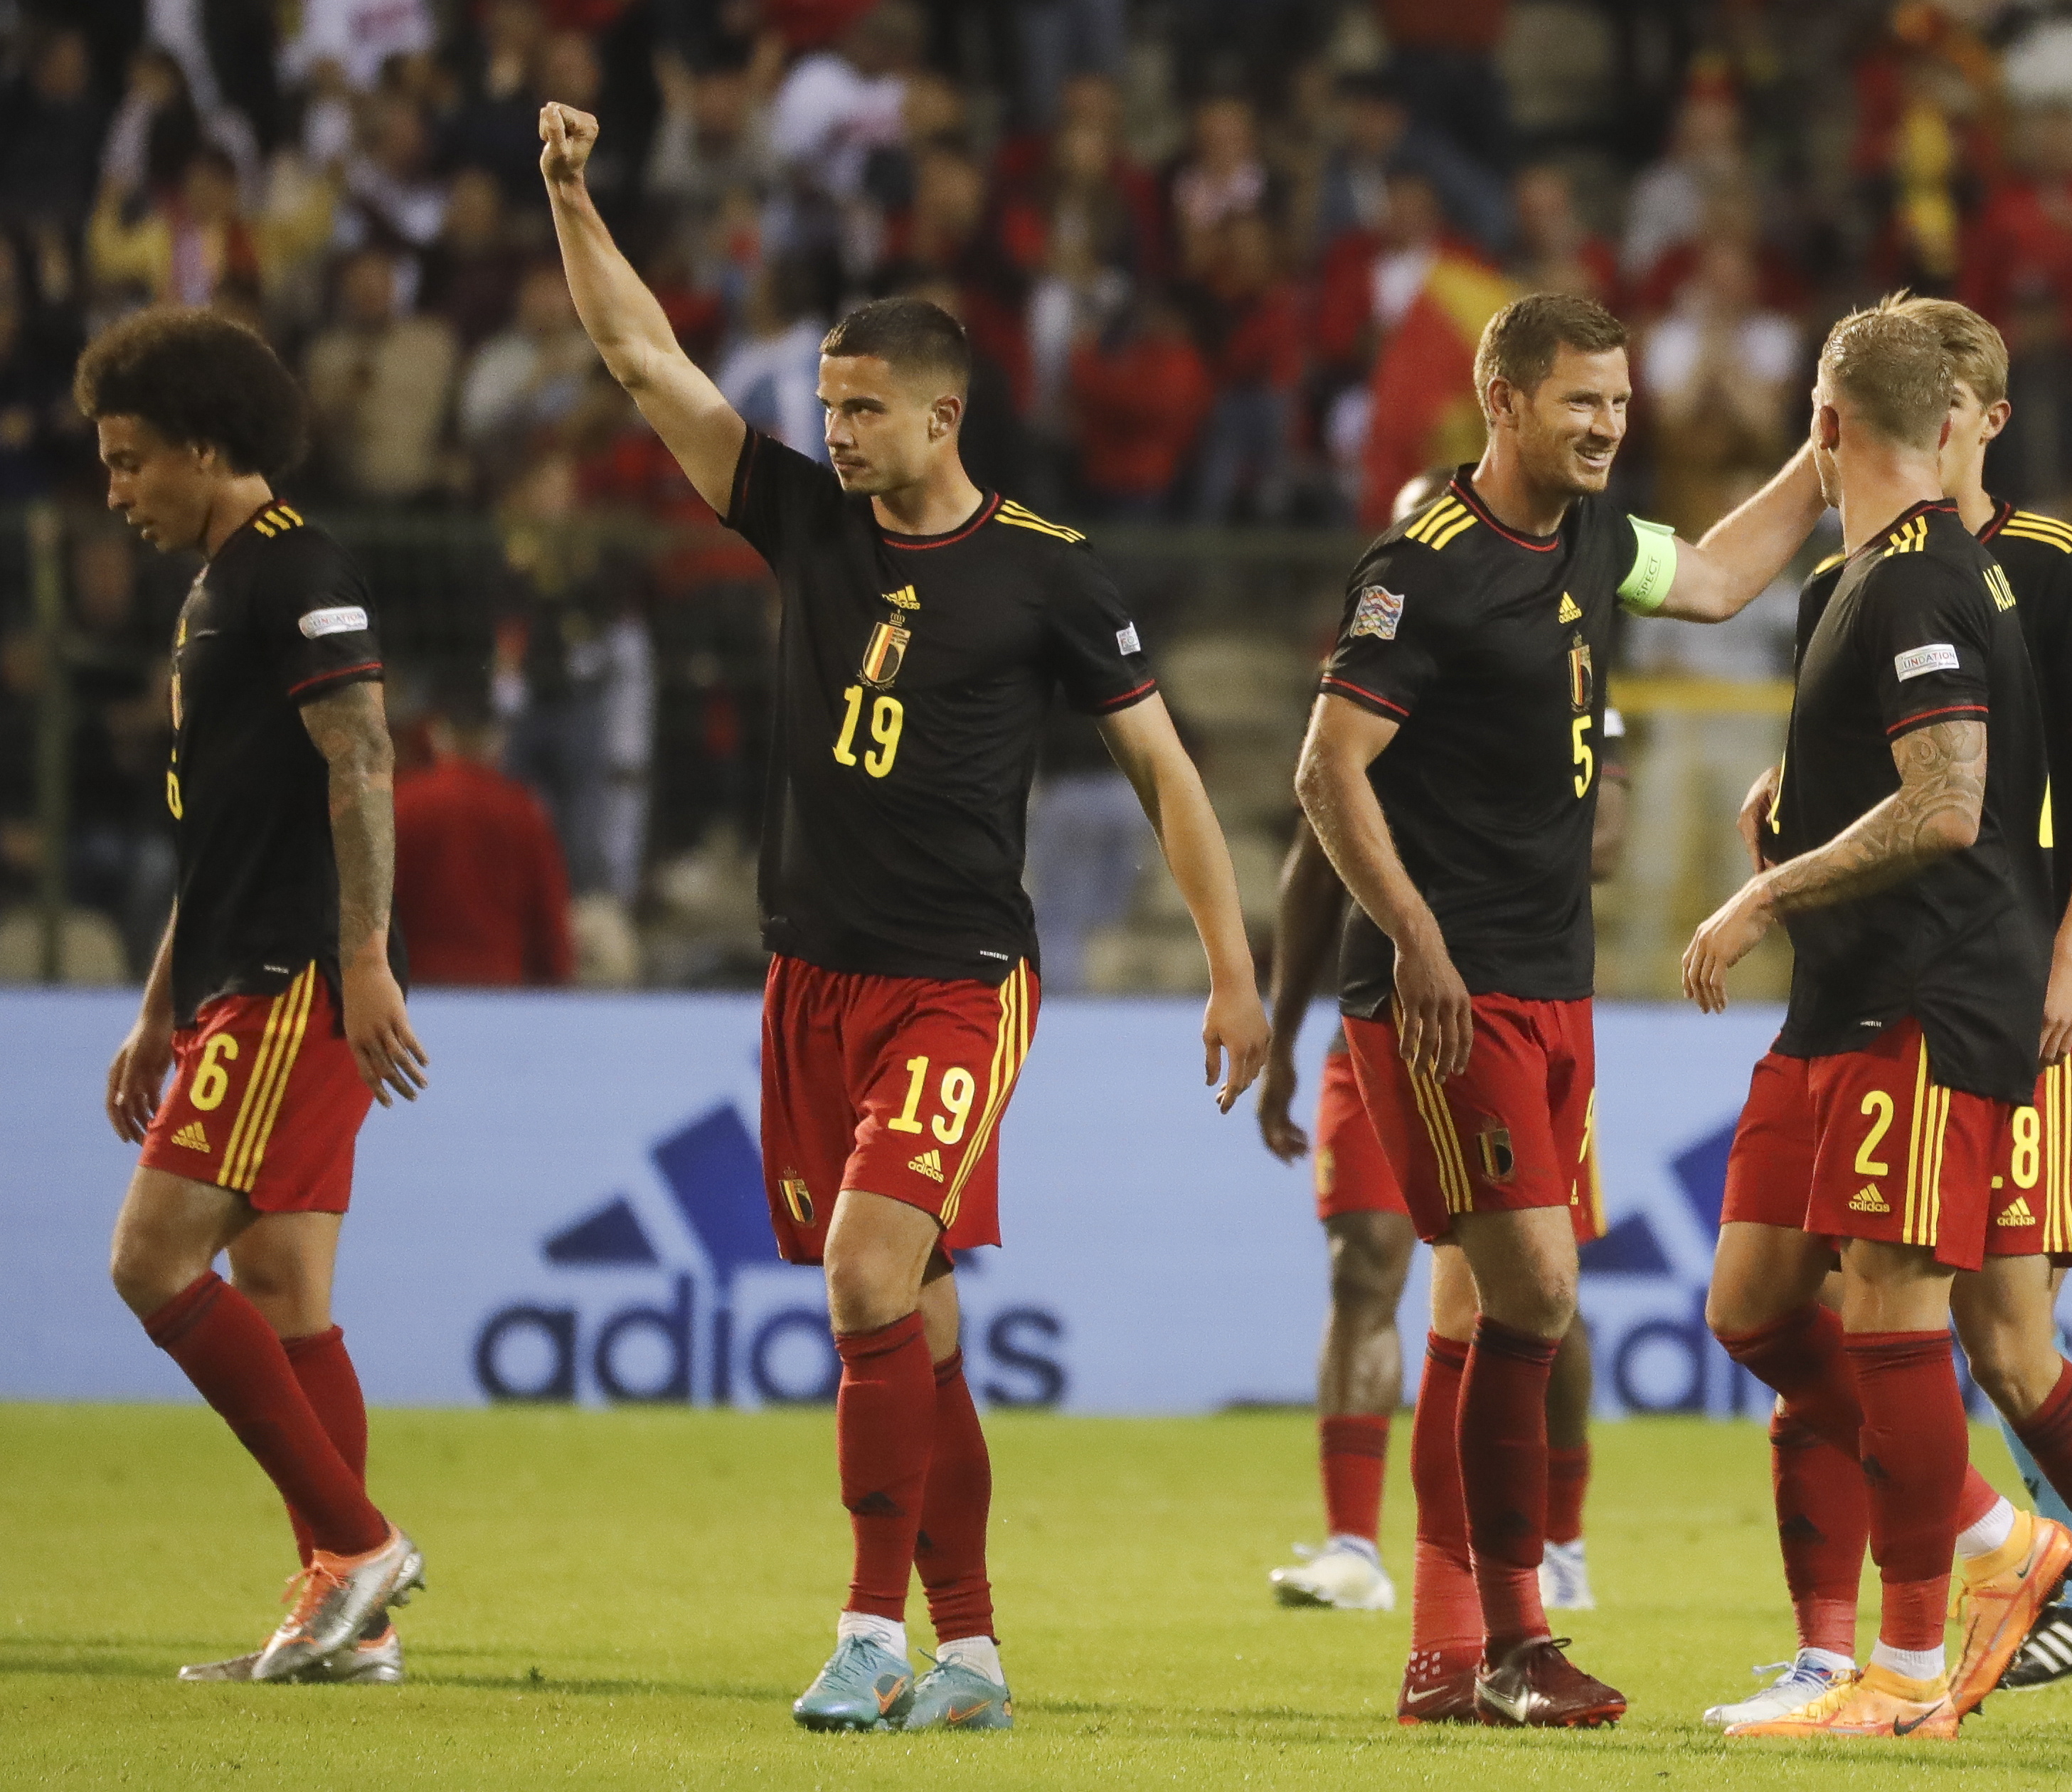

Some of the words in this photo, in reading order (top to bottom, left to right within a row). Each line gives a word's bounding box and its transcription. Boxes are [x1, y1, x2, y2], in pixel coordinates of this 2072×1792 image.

[832, 685, 903, 778] 19
[1573, 715, 1593, 798] 5
[189, 1033, 240, 1111] 6
[888, 1056, 975, 1145] 19
[908, 1161, 945, 1184] adidas
[1854, 1090, 1894, 1176] 2
[1992, 1106, 2040, 1189] 8
[1849, 1200, 1891, 1213] adidas
[1997, 1215, 2036, 1227] adidas
[475, 1273, 1068, 1407] adids
